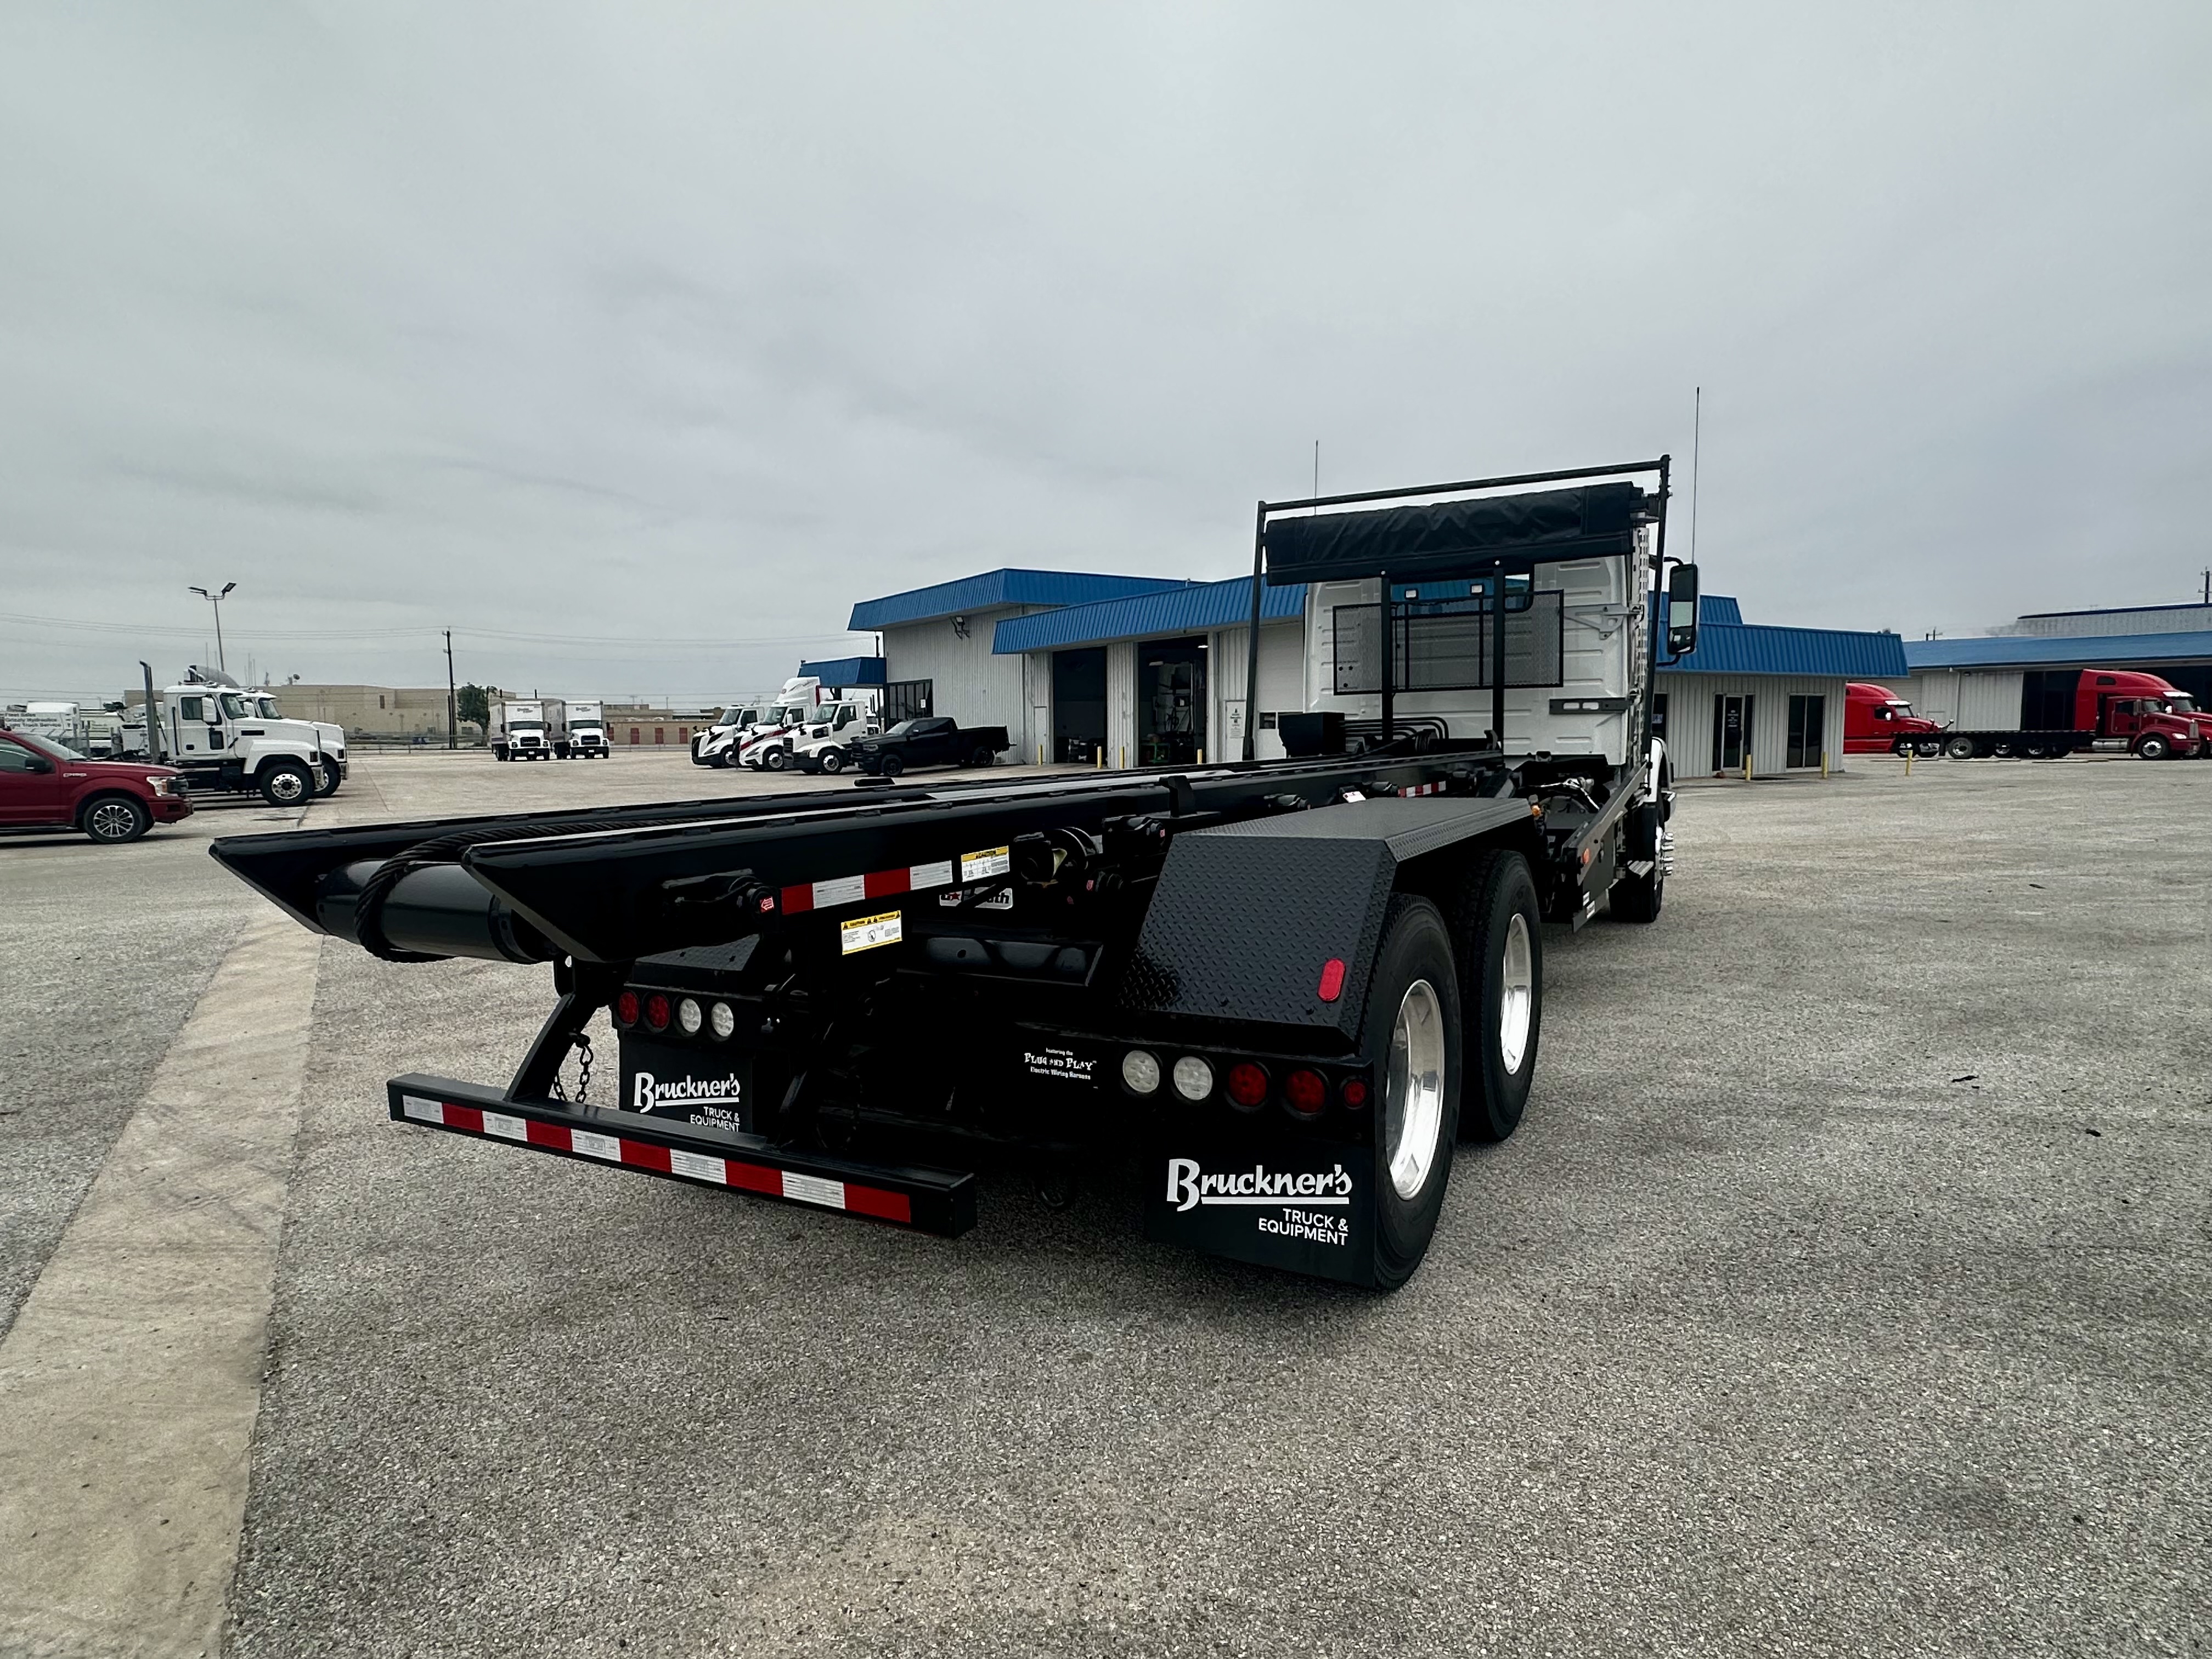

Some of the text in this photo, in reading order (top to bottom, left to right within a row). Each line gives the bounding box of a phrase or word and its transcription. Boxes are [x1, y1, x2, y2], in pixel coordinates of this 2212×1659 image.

[1024, 1052, 1093, 1071] PLUG AND PLAY
[633, 1071, 741, 1114] Bruckner's
[690, 1114, 741, 1132] EQUIPMENT
[703, 1105, 740, 1122] TRUCK &
[1166, 1158, 1353, 1212] Bruckner's
[1258, 1217, 1348, 1246] EQUIPMENT
[1283, 1207, 1349, 1232] TRUCK &
